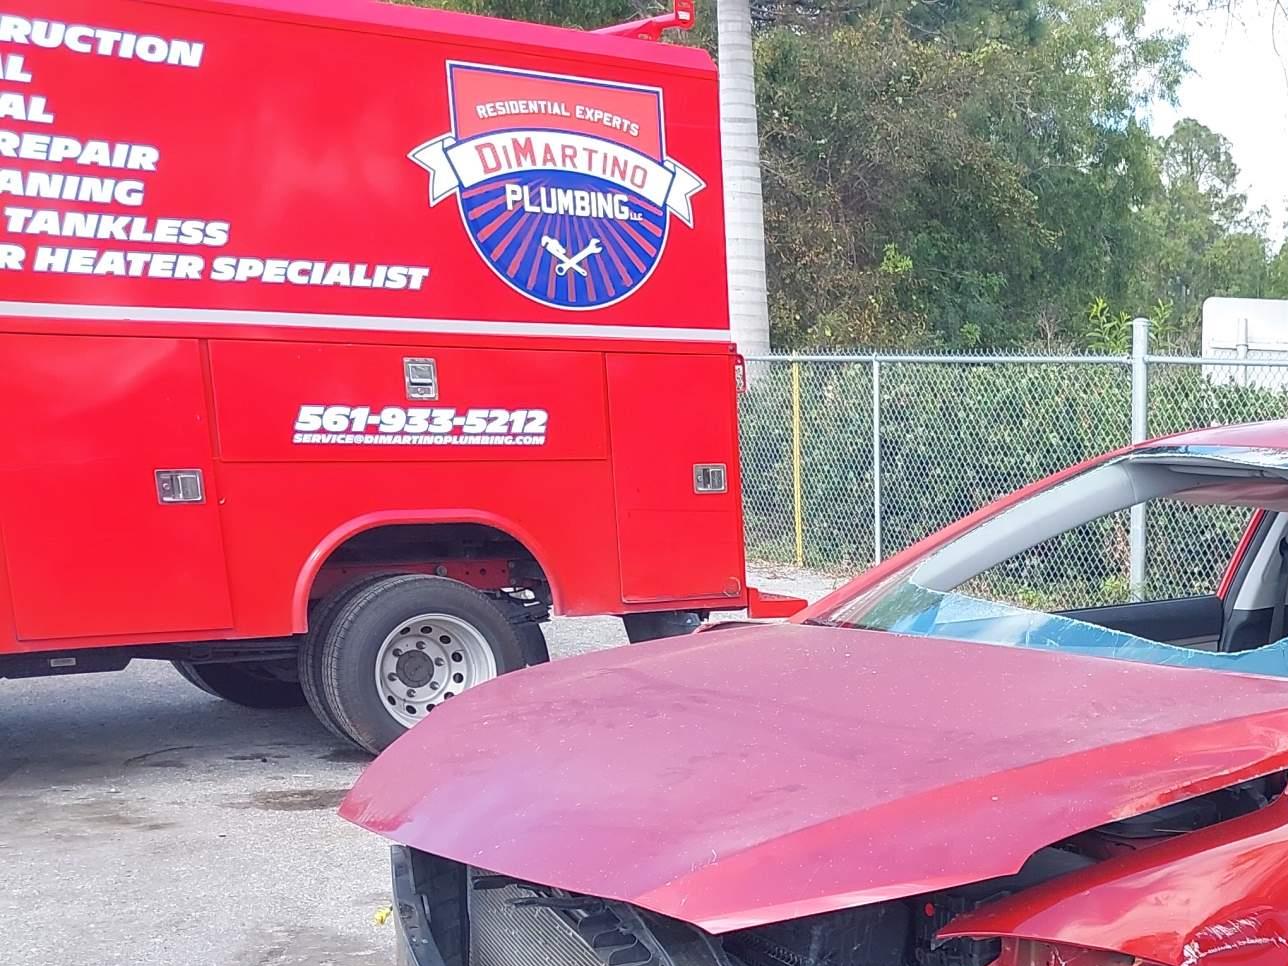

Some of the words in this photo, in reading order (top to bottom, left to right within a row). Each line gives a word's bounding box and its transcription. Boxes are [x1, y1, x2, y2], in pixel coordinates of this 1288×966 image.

[0, 14, 204, 67] RUCTION
[475, 100, 571, 119] RESIDENTIAL
[575, 104, 640, 137] EXPERTS
[0, 130, 160, 171] REPAIR
[0, 168, 144, 206] ANING
[505, 184, 630, 220] PLUMBING
[630, 211, 643, 222] LLC
[4, 206, 230, 246] TANKLESS
[33, 246, 205, 280] HEATER
[210, 256, 430, 290] SPECIALIST
[294, 406, 548, 433] 561-933-5212
[293, 433, 546, 446] SERVICE@DIMARTINOPLUMBING.COM
